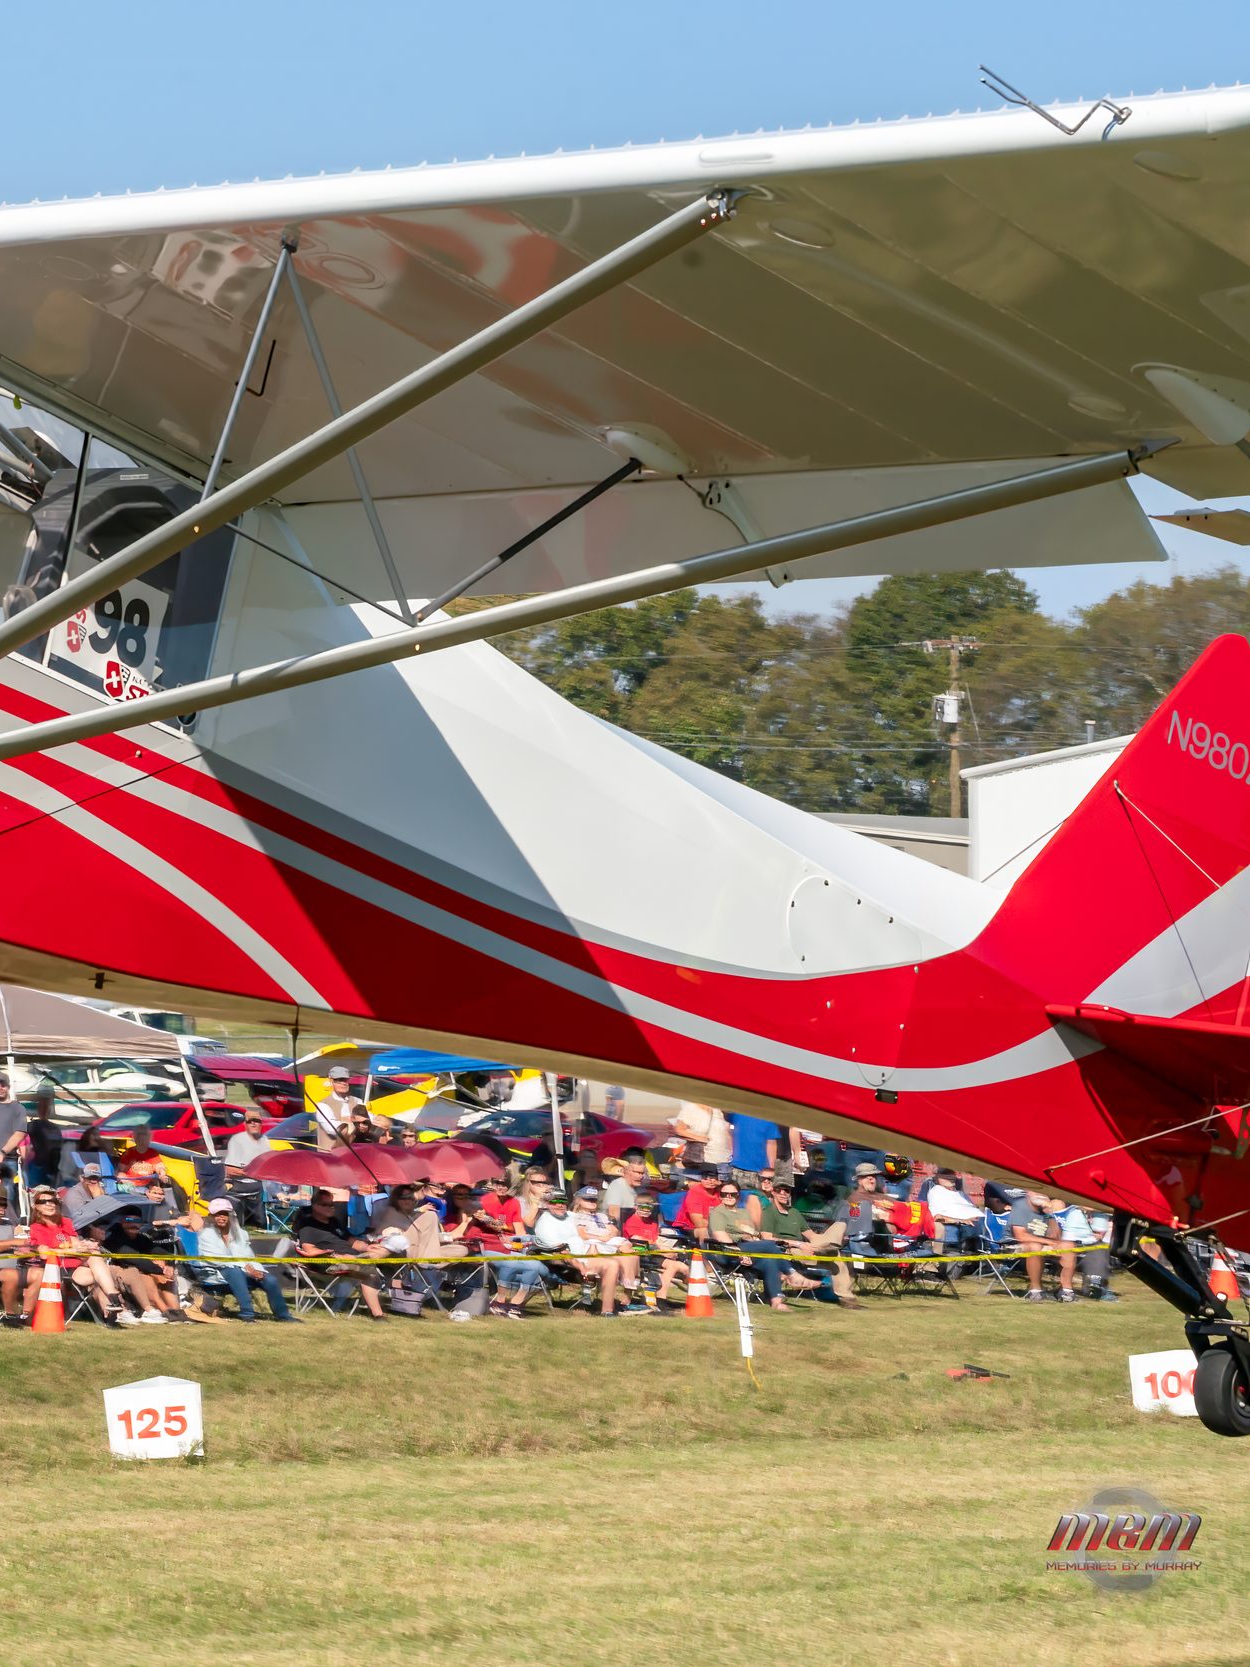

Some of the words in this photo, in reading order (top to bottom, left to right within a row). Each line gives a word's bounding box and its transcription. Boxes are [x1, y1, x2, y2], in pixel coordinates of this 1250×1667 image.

[88, 588, 150, 668] 98
[1167, 709, 1250, 785] N980
[117, 1405, 188, 1440] 125
